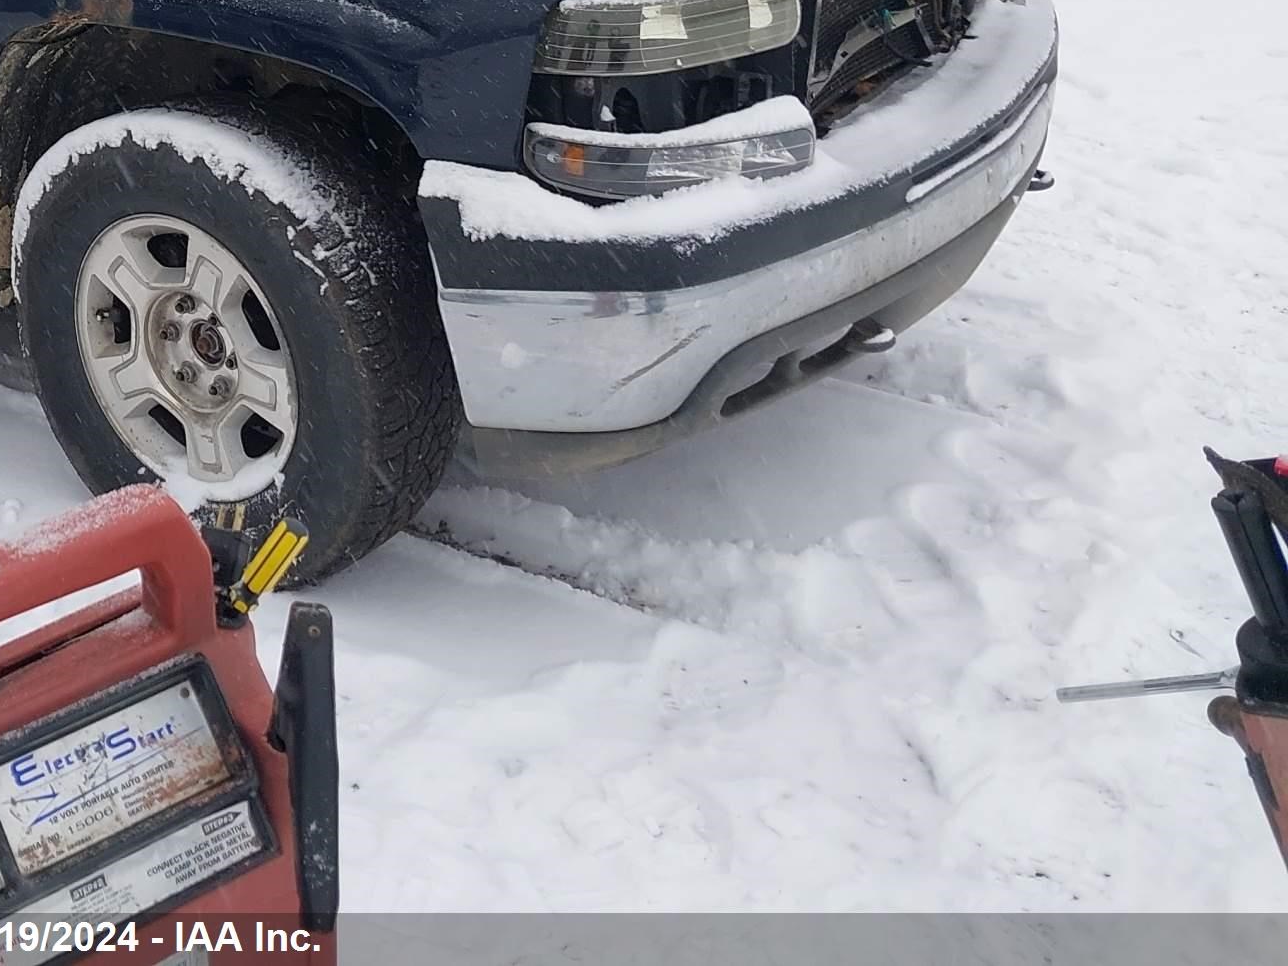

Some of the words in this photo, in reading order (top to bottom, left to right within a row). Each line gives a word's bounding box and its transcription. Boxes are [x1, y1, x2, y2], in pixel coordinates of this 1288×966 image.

[59, 805, 79, 819] VOLT
[79, 786, 119, 809] PORTABLE
[119, 776, 141, 791] AUTO
[146, 852, 183, 877] CONNECT
[183, 841, 210, 857] BLACK
[209, 822, 247, 844] NEGATIVE
[163, 860, 193, 878] CLAMP
[192, 854, 204, 864] TO
[203, 843, 225, 858] BARE
[225, 830, 251, 847] METAL
[173, 868, 198, 884] AWAY
[197, 856, 221, 871] FROM
